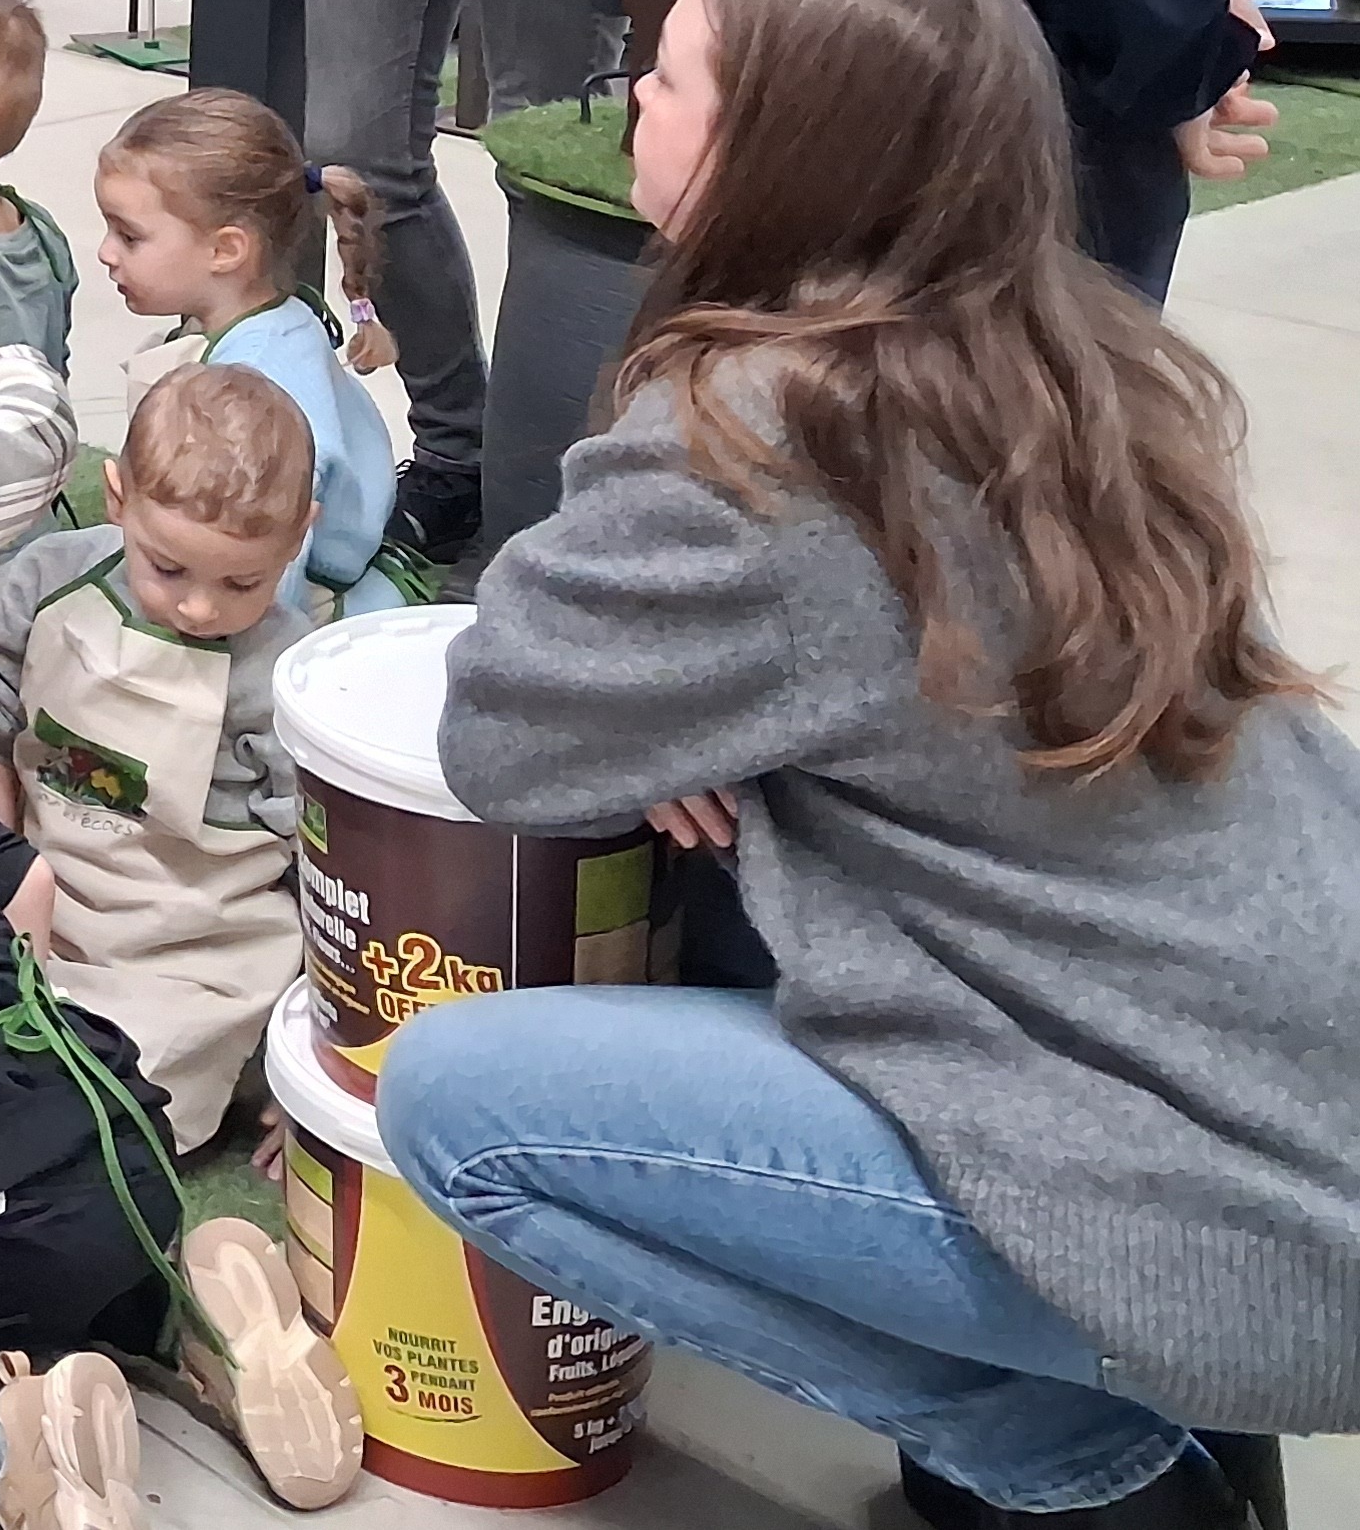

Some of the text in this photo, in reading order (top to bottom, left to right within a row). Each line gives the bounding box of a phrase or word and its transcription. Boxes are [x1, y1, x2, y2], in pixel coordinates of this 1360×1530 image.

[372, 1338, 480, 1374] VOS PLANTES
[387, 1326, 457, 1354] NOURRIT
[383, 1363, 476, 1403] 3 PENDANT
[417, 1389, 474, 1415] MOIS
